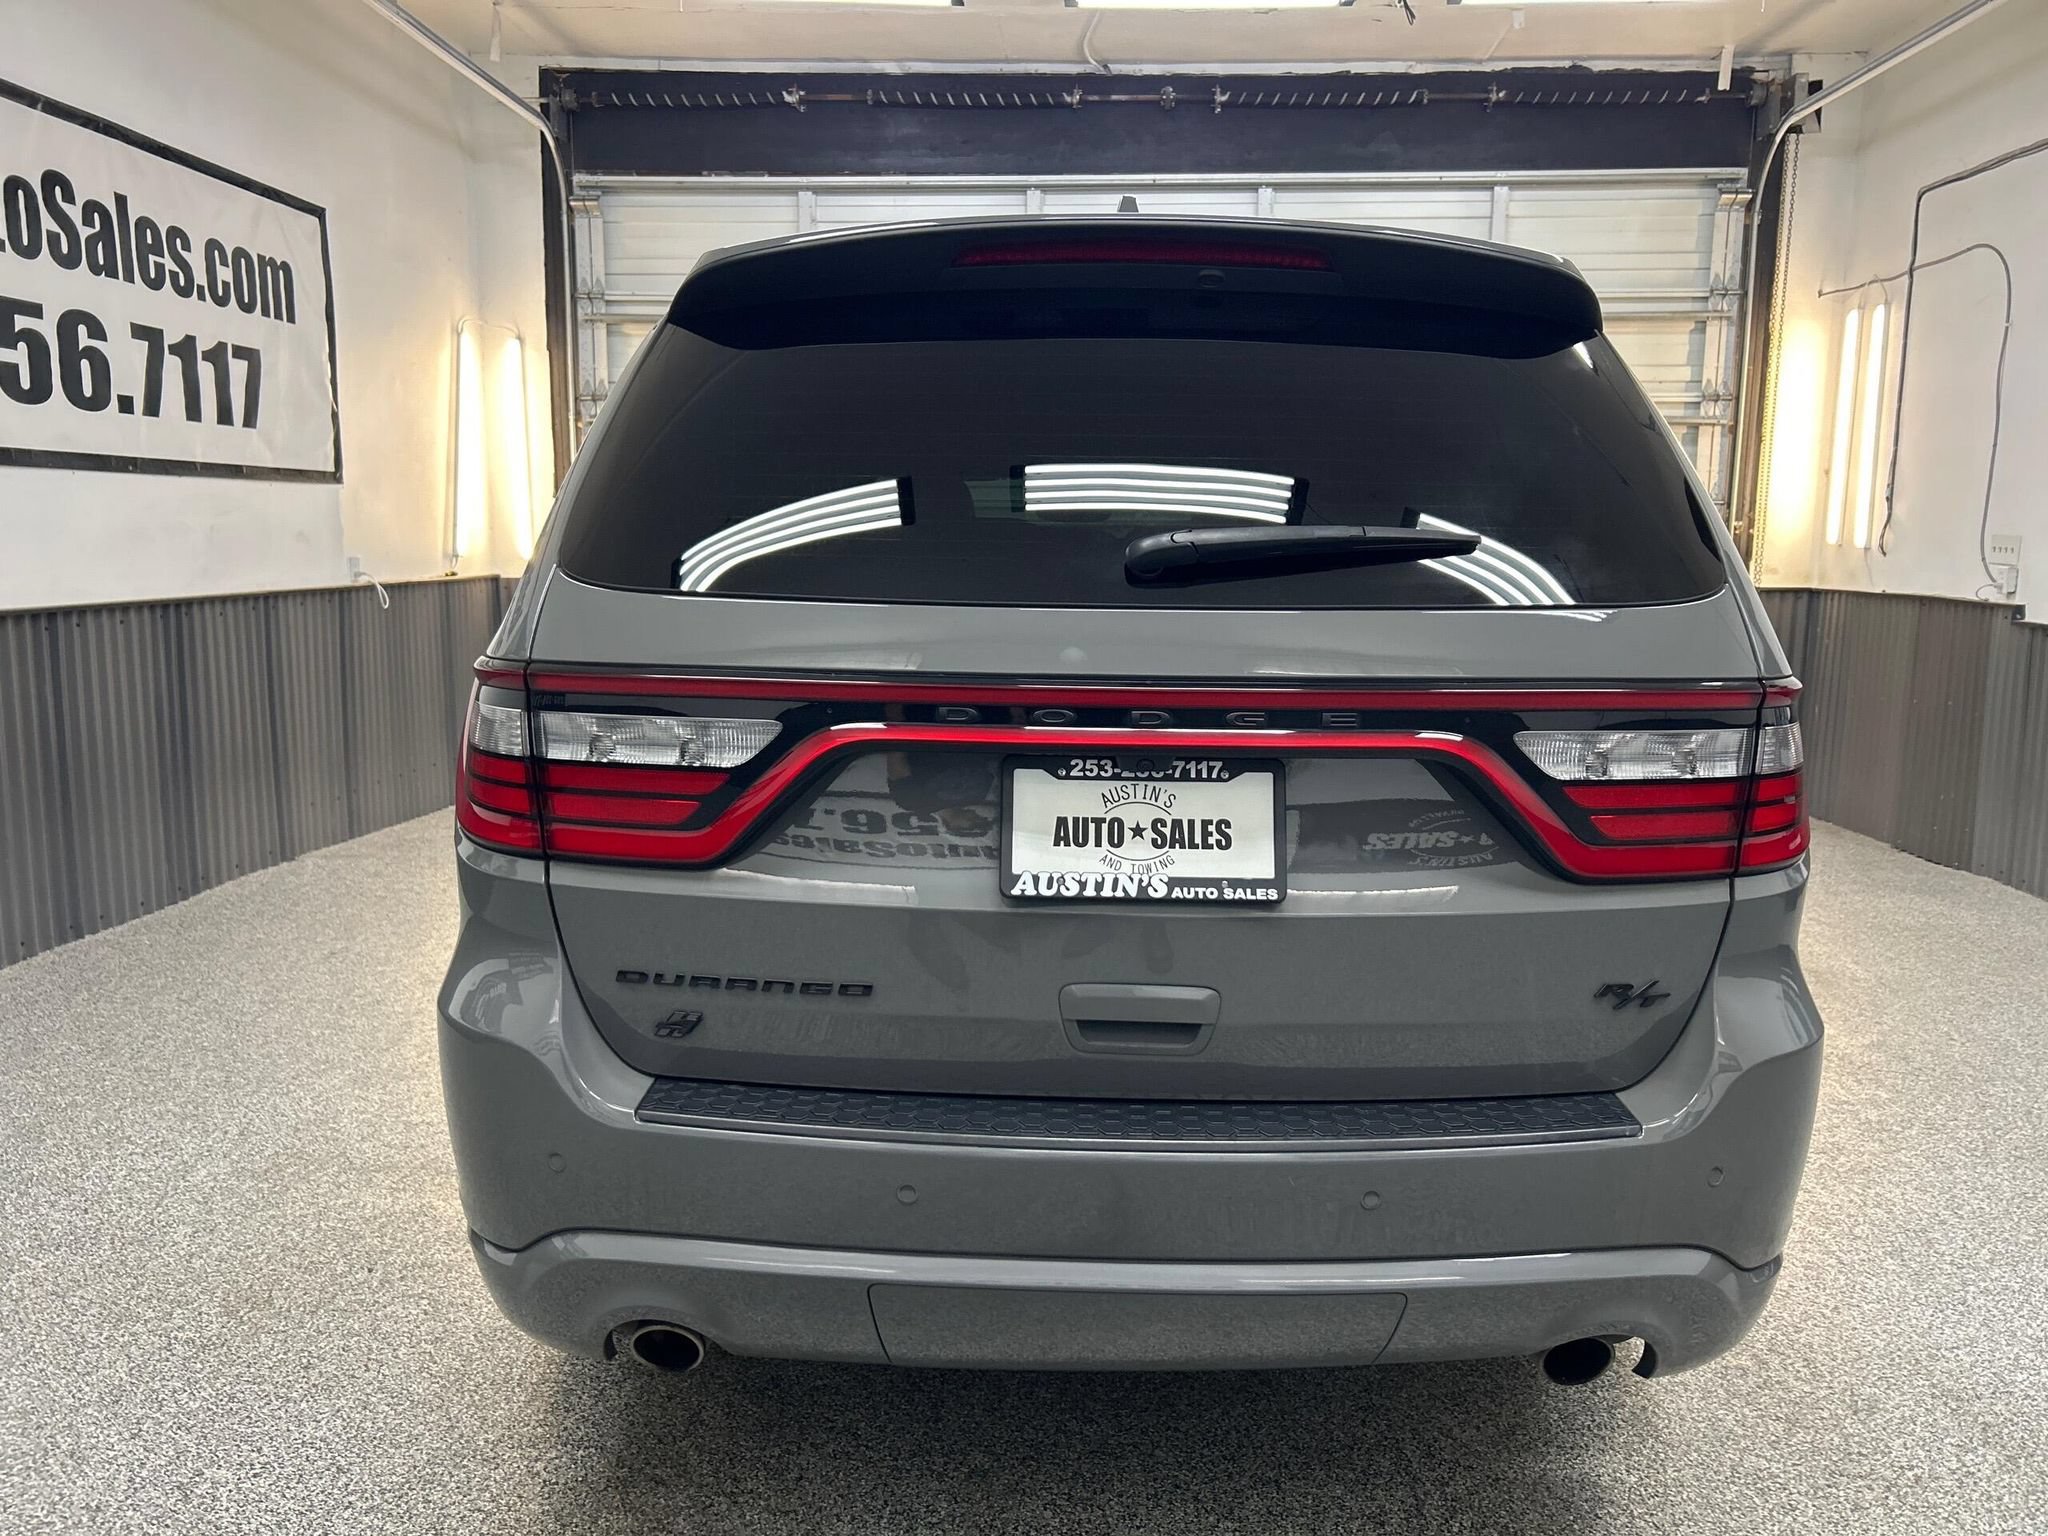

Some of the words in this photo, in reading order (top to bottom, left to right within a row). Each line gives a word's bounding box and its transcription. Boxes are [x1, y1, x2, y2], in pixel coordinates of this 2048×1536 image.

[0, 169, 296, 325] oSales.com
[937, 706, 1360, 728] DODGE
[1101, 783, 1177, 808] AUSTIN'S
[1053, 816, 1125, 848] AUTO
[1151, 817, 1232, 850] SALES
[1099, 854, 1122, 872] AND
[1130, 854, 1176, 875] TOWING
[1011, 870, 1169, 898] AUSTIN'S
[1171, 887, 1218, 899] AUTO
[1223, 887, 1279, 900] SALES
[615, 969, 874, 996] DURANGO
[1594, 978, 1671, 1010] R/T
